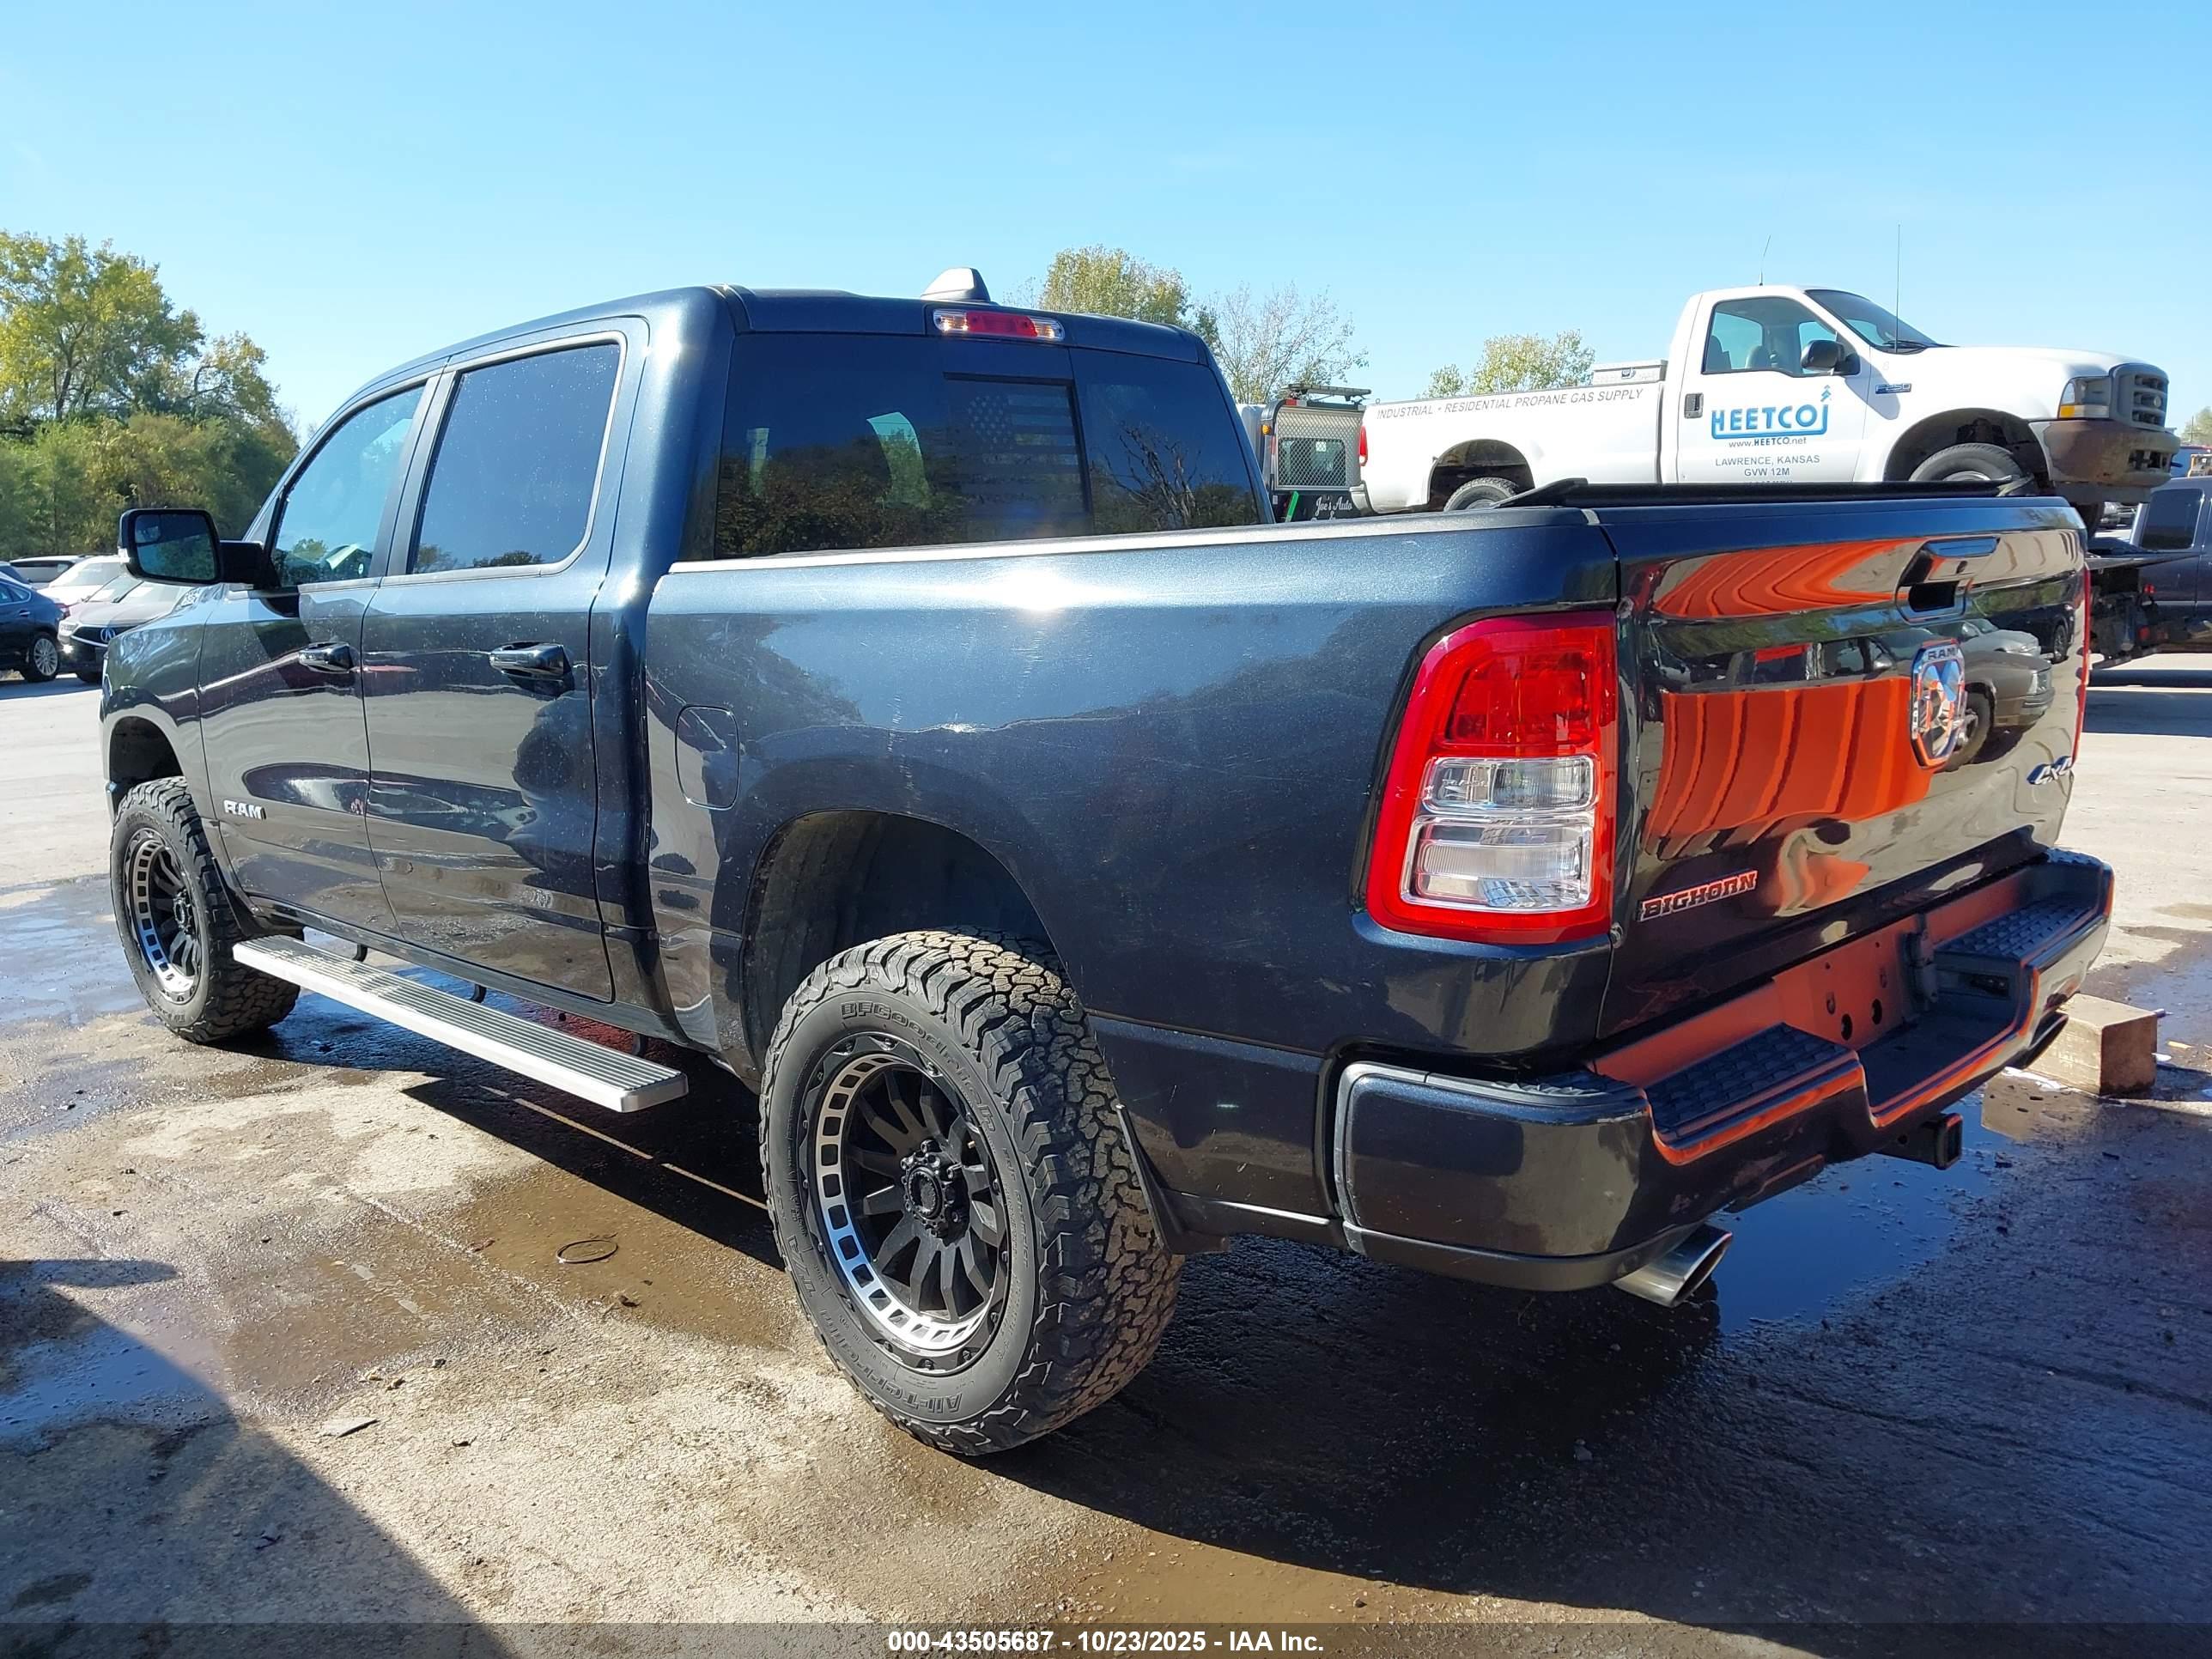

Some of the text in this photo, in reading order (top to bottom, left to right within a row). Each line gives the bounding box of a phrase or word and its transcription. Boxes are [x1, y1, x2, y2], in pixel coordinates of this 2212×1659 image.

[1376, 405, 1433, 419] INDUSTRIAL
[1444, 398, 1511, 413] RESIDENTIAL
[1515, 393, 1568, 407] PROPANE
[1571, 392, 1595, 404] GAS
[1597, 388, 1644, 402] SUPPLY
[1711, 404, 1818, 432] HEETCO
[1729, 436, 1808, 448] www.HEETCO.net
[1715, 455, 1820, 466] LAWRENCE, KANSAS
[1744, 467, 1790, 477] GVW 12M
[1315, 495, 1353, 516] Joe's Auto
[1928, 647, 1956, 660] RAM
[223, 799, 266, 820] RAM
